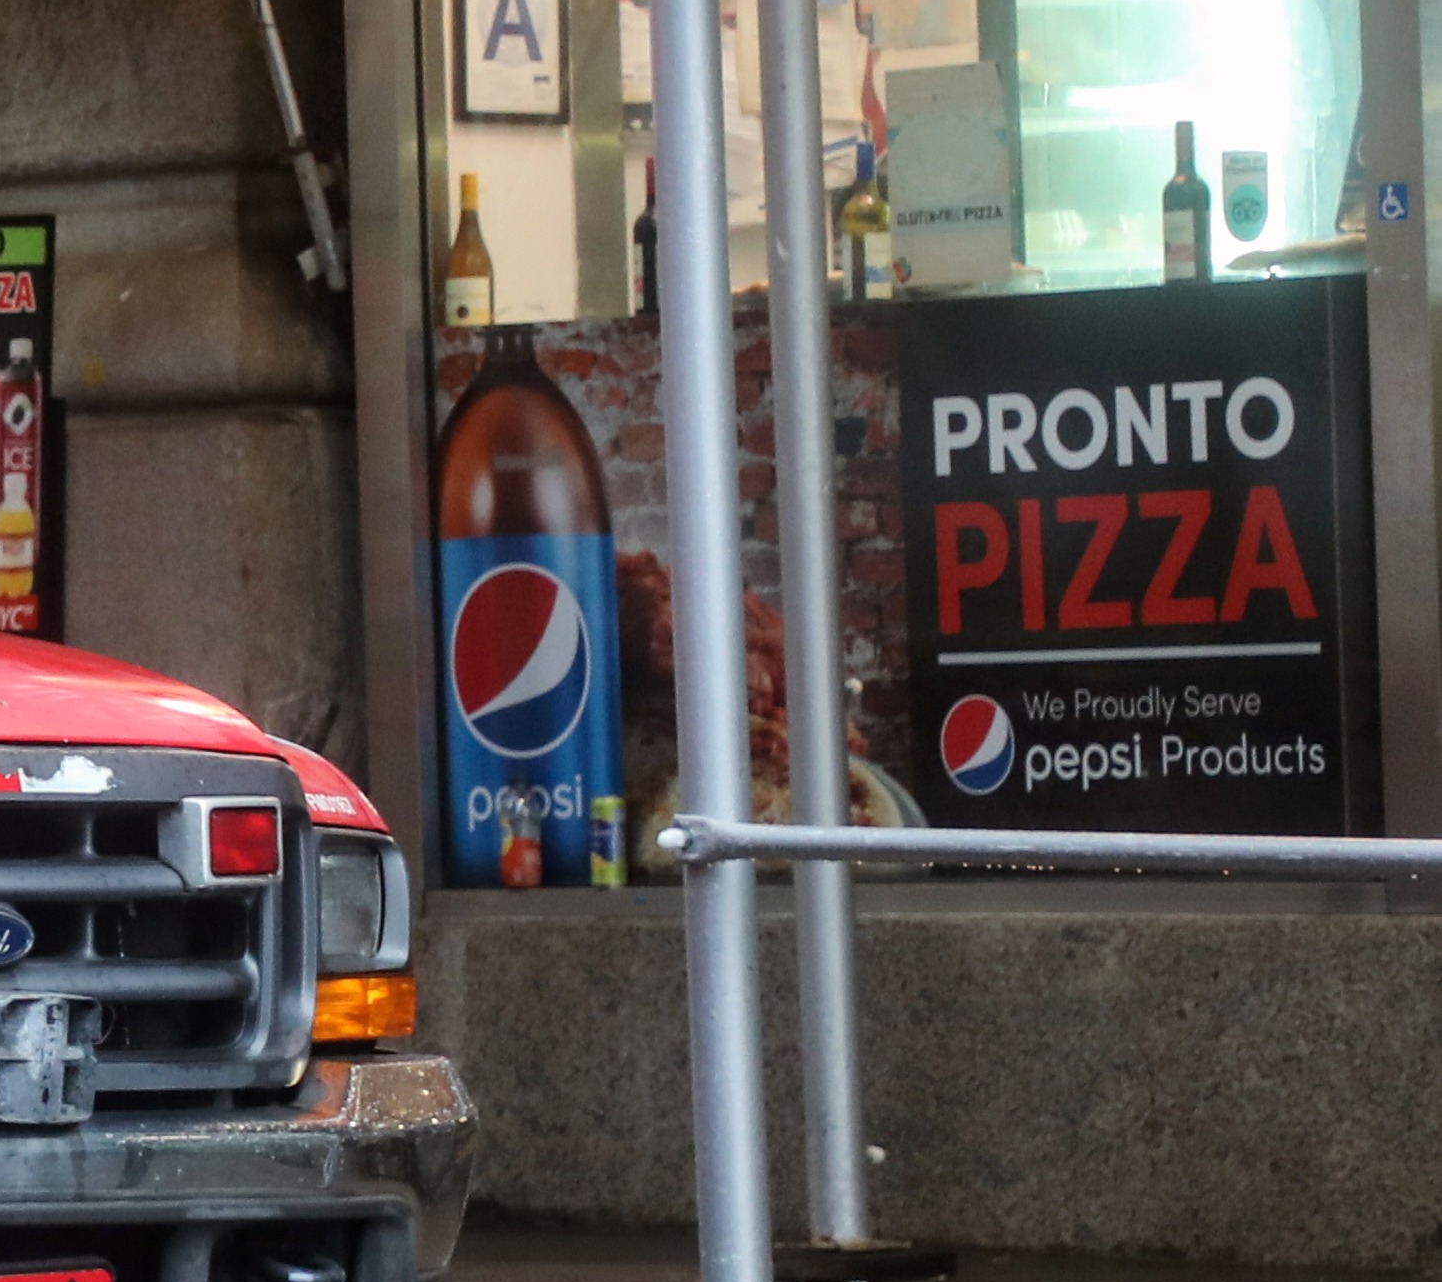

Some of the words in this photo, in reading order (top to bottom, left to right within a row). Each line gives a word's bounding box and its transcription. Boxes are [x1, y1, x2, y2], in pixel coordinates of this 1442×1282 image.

[932, 375, 1296, 478] PRONTO
[934, 485, 1318, 636] PIZZA
[1022, 689, 1065, 721] We
[1075, 686, 1175, 725] Proudly
[1184, 684, 1261, 718] Serve
[1024, 732, 1143, 793] pepsi
[1161, 732, 1326, 778] Products
